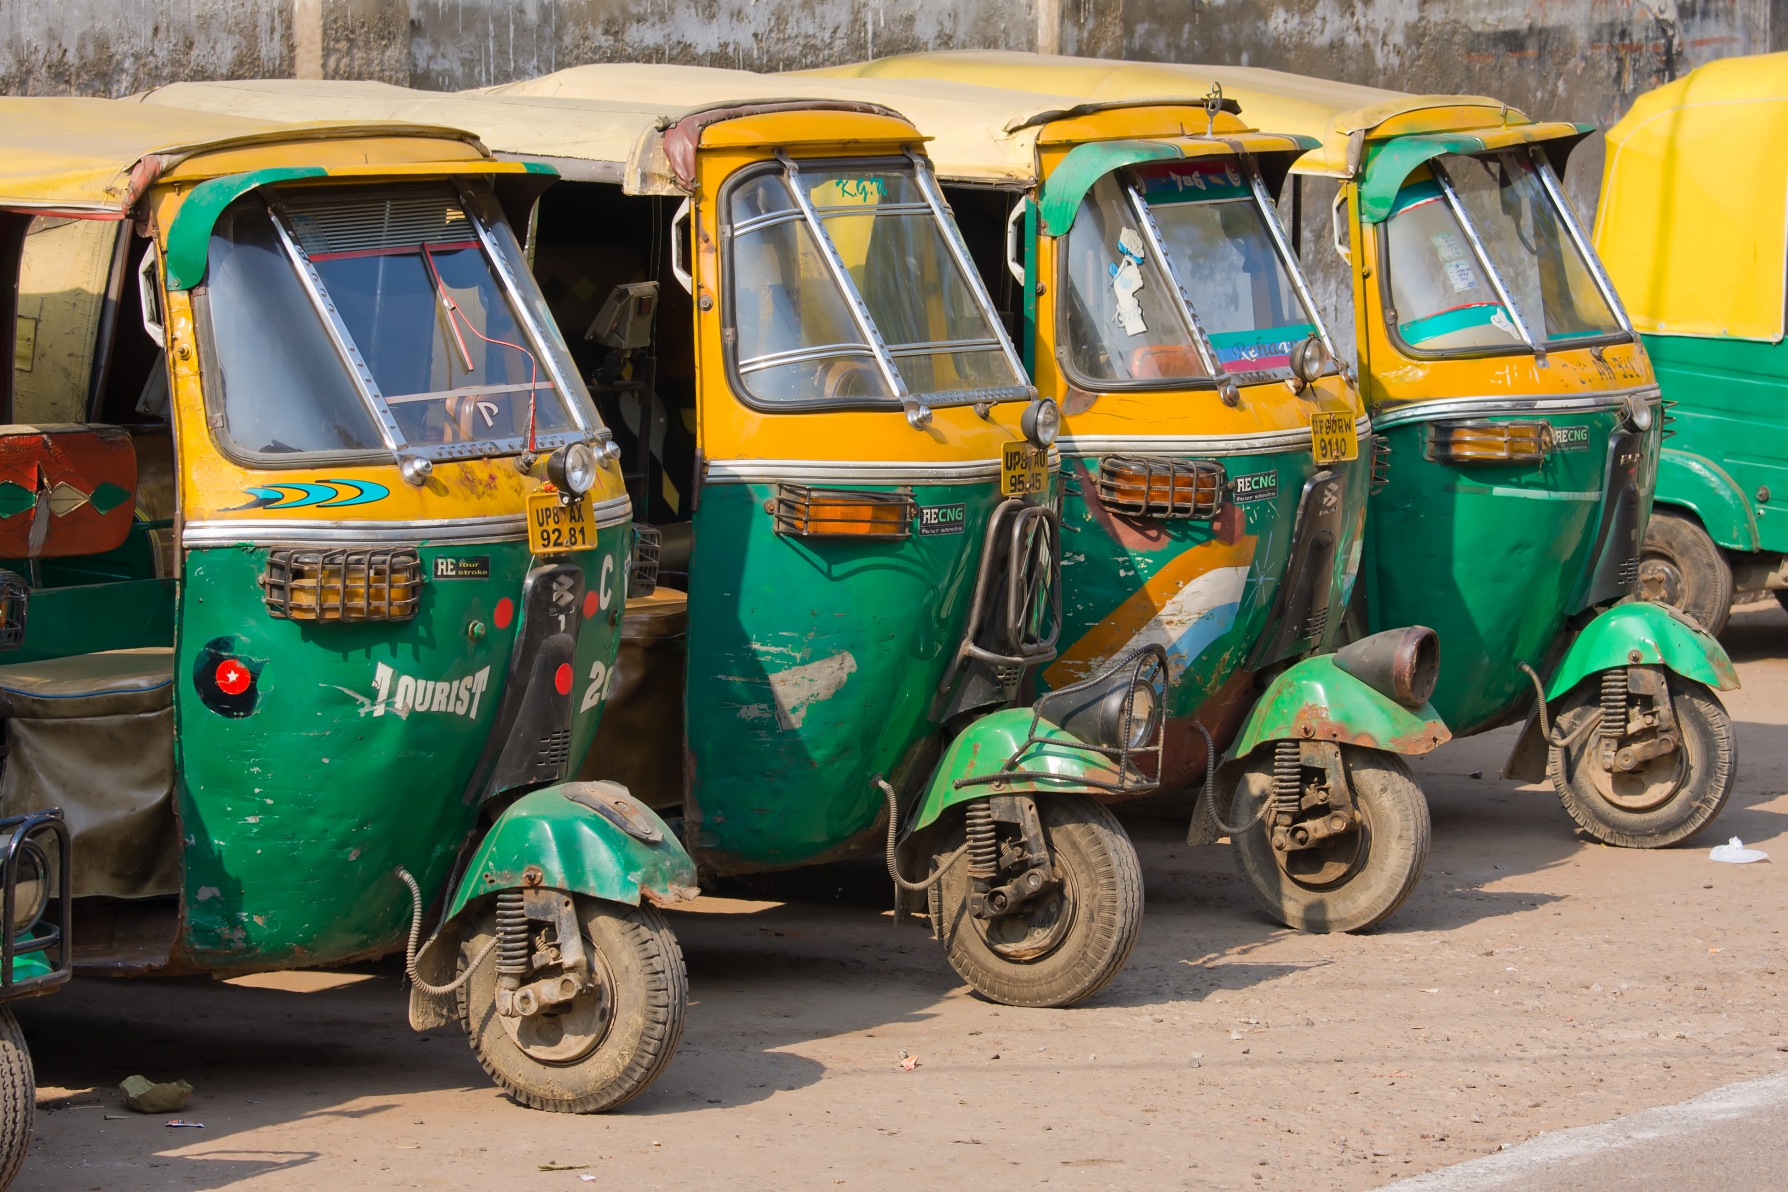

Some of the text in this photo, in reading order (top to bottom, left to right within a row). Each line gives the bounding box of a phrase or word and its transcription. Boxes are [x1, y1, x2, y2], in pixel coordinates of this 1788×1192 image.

[1169, 170, 1206, 193] 786
[1320, 437, 1347, 459] 9110
[1005, 451, 1030, 471] UP8
[536, 506, 565, 527] UP8
[437, 558, 456, 576] RE
[371, 661, 491, 720] TOURIST
